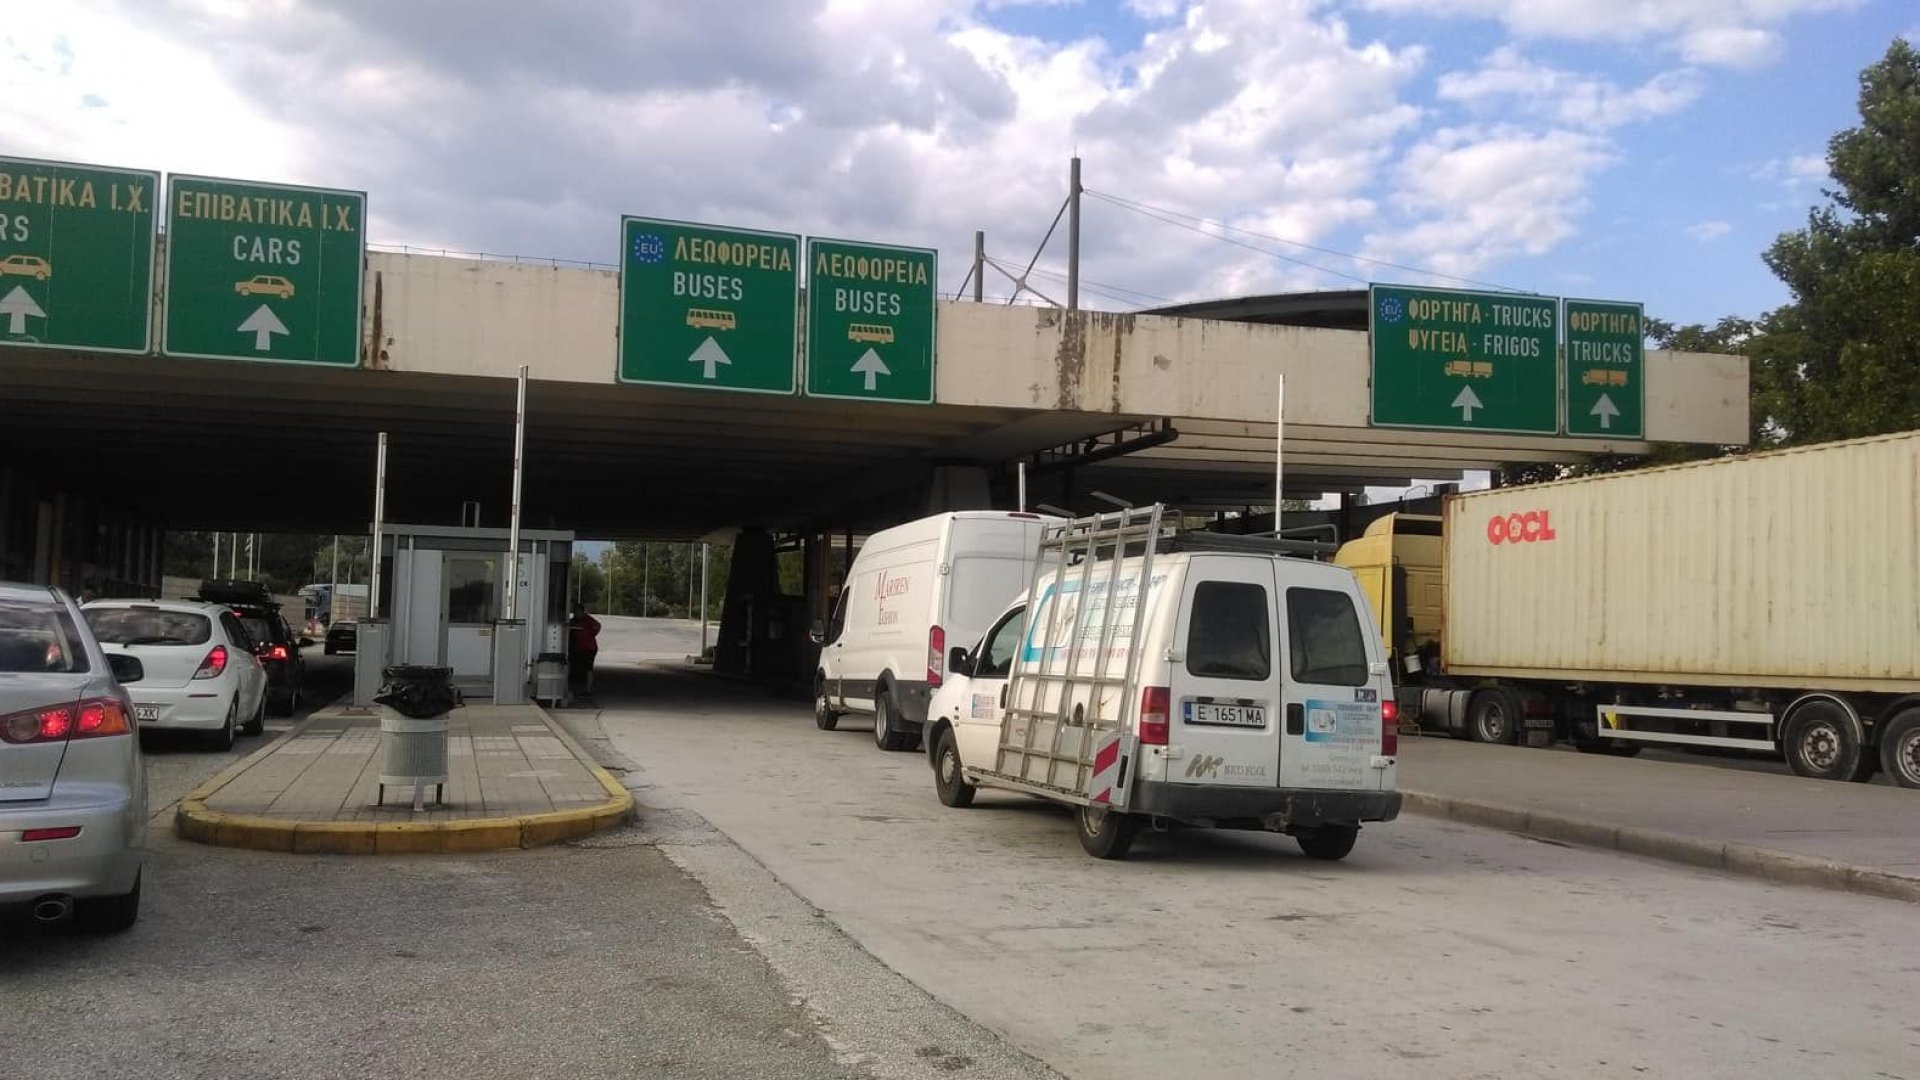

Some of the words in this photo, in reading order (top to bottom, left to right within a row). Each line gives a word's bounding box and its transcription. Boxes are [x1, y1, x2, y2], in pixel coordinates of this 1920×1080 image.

[178, 191, 313, 228] ΕΠΙΒΑΤΙΚΑ
[233, 235, 302, 266] CARS
[640, 242, 658, 254] EU
[674, 236, 793, 272] ΛΕΩΦΟΡΕΙΑ
[815, 252, 928, 286] ΛΕΩΦΟΡΕΙΑ
[673, 271, 744, 301] BUSES
[835, 288, 901, 316] BUSES
[1408, 298, 1482, 324] ΦΟΡΤΗΓΑ
[1492, 304, 1552, 329] TRUCKS
[1570, 311, 1637, 335] ΦΟΡΤΗΓΑ
[1408, 329, 1468, 354] ΨΥΓΕΙΑ
[1483, 333, 1540, 358] FRIGOS
[1572, 340, 1633, 363] TRUCKS
[1488, 510, 1556, 545] OOCL
[1214, 707, 1242, 722] 1651
[1246, 709, 1263, 724] MA
